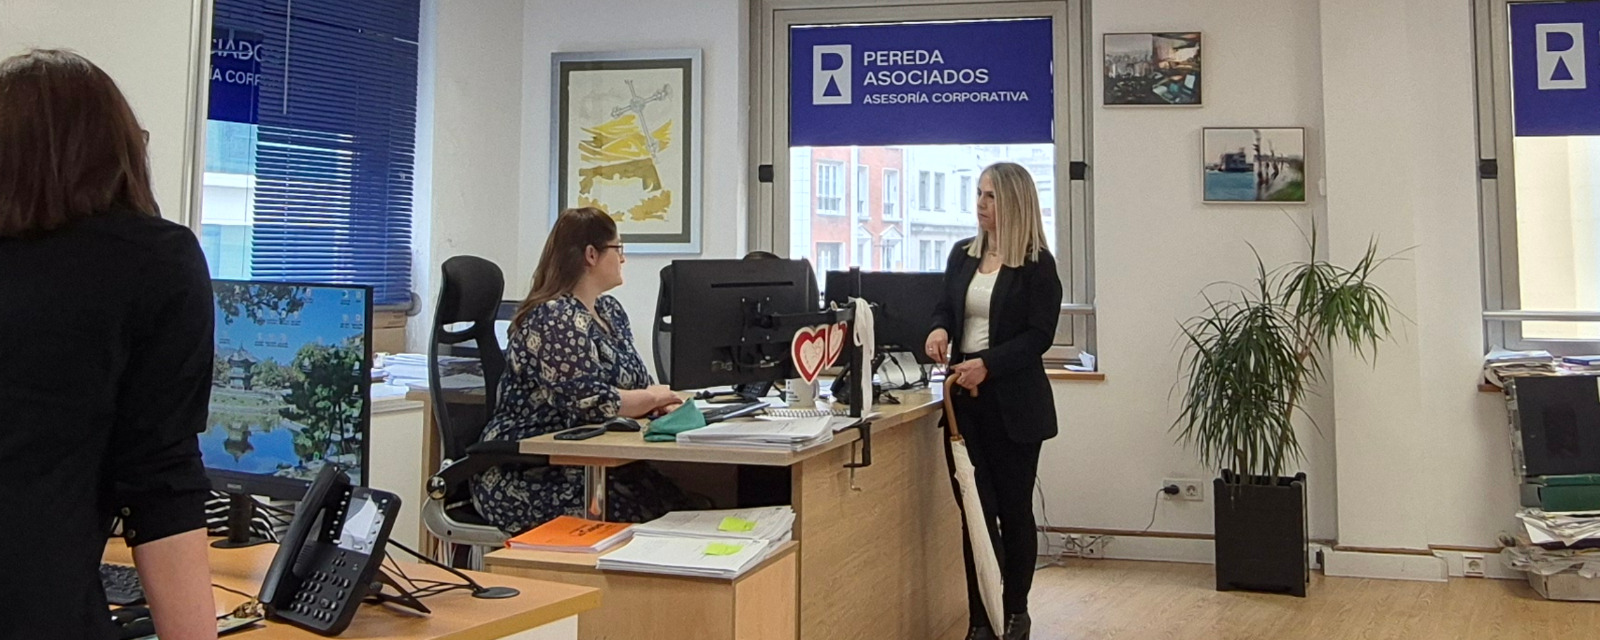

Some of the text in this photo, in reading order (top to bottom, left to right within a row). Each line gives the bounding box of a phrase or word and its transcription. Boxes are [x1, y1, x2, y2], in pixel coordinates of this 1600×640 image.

[863, 49, 944, 66] PEREDA
[863, 68, 989, 86] ASOCIADOS
[863, 91, 1029, 105] ASESORÍA CORPORATIVA
